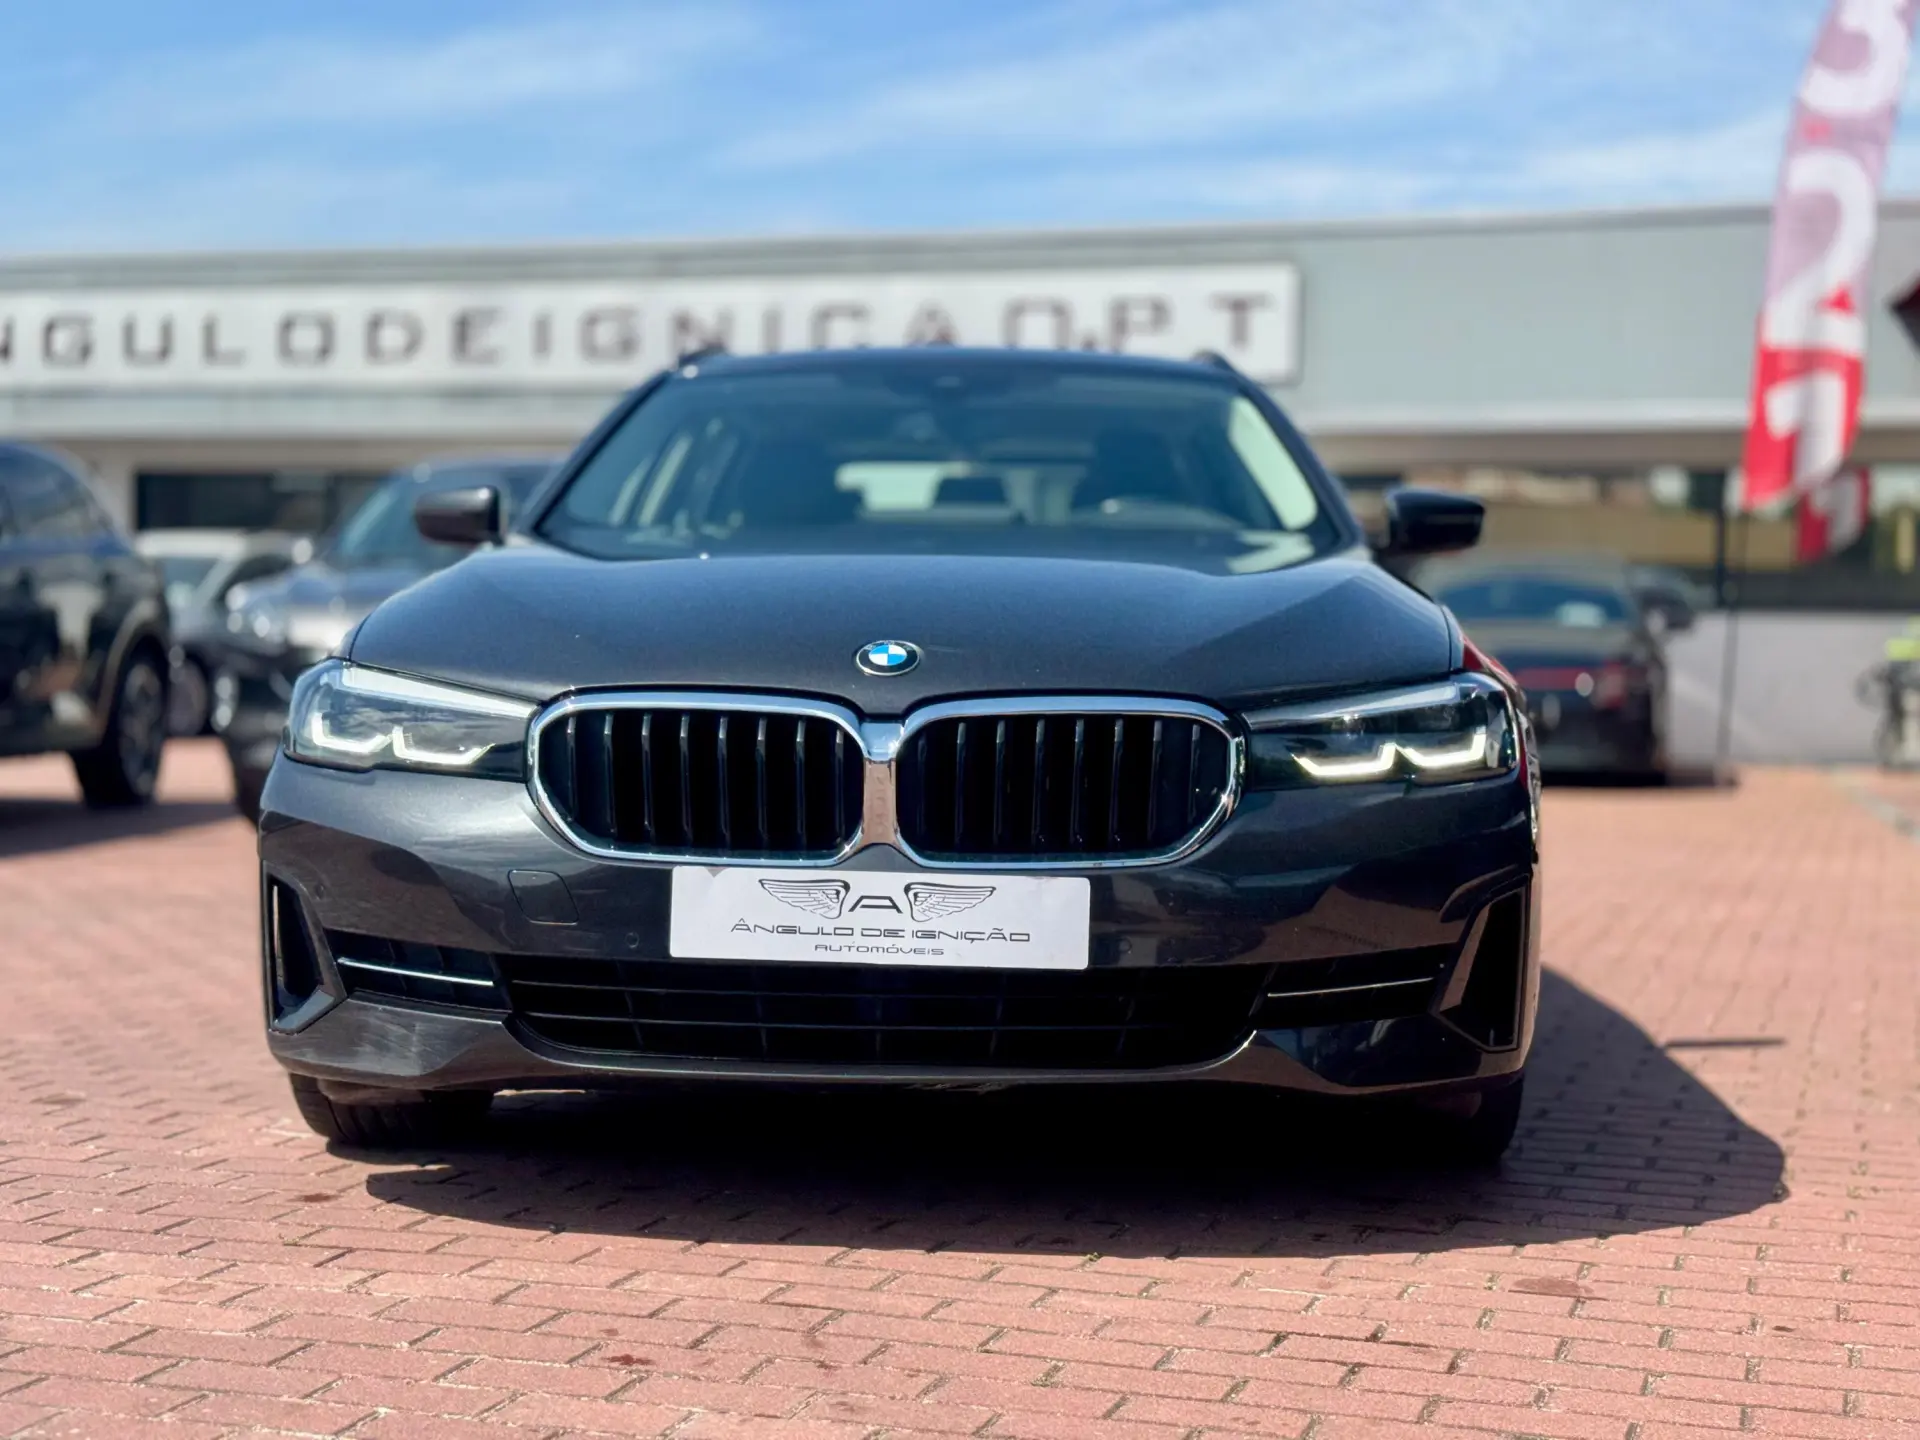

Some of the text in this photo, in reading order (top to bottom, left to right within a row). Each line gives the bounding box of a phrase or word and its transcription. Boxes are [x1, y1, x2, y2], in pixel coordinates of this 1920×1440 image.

[0, 292, 1273, 367] GULODEIGNICAO.PT
[731, 917, 1030, 944] ÂNGULO DE IGNIÇÃO
[814, 941, 944, 956] AUTOMÓVEIS
